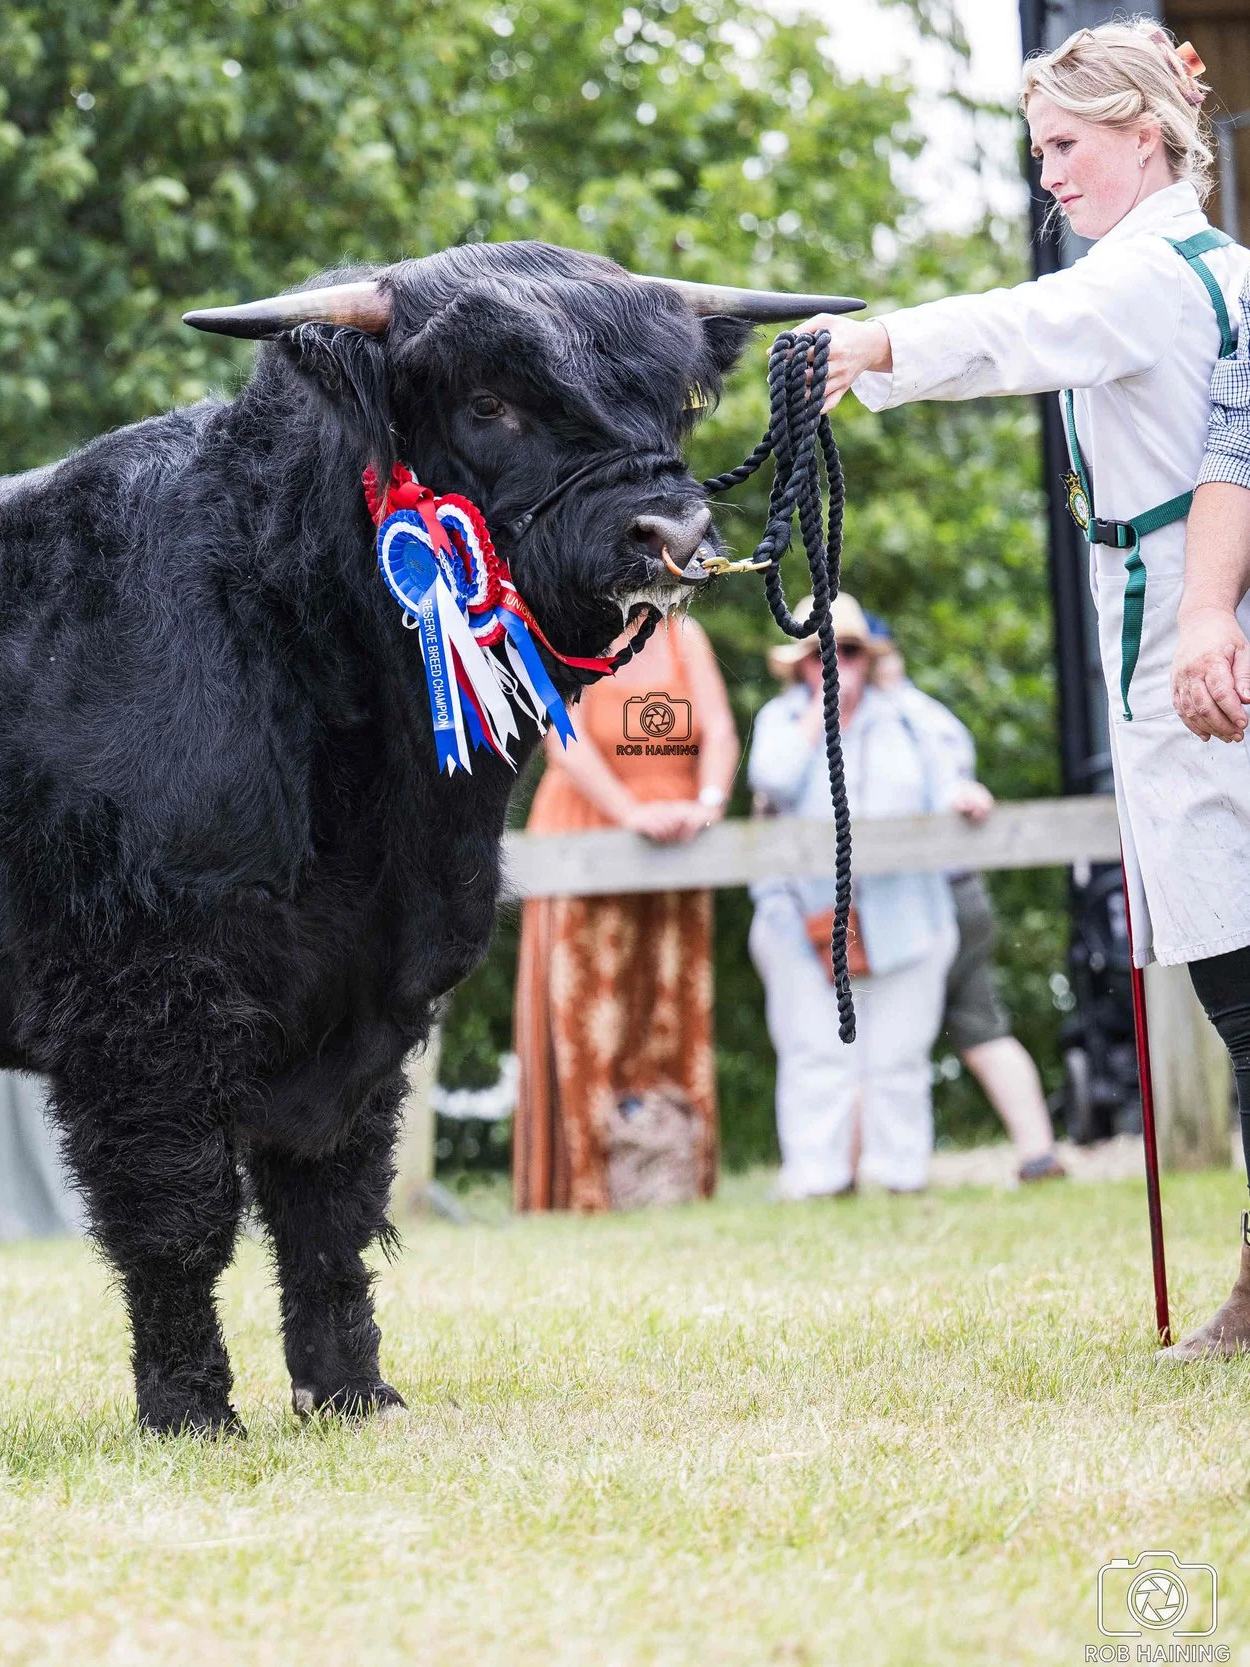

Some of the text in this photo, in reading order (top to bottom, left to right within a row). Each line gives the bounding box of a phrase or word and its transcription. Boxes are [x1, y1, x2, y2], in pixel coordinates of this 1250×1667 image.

[502, 593, 532, 621] JUNIOR
[422, 599, 449, 728] RESERVE BREED CHAMPION
